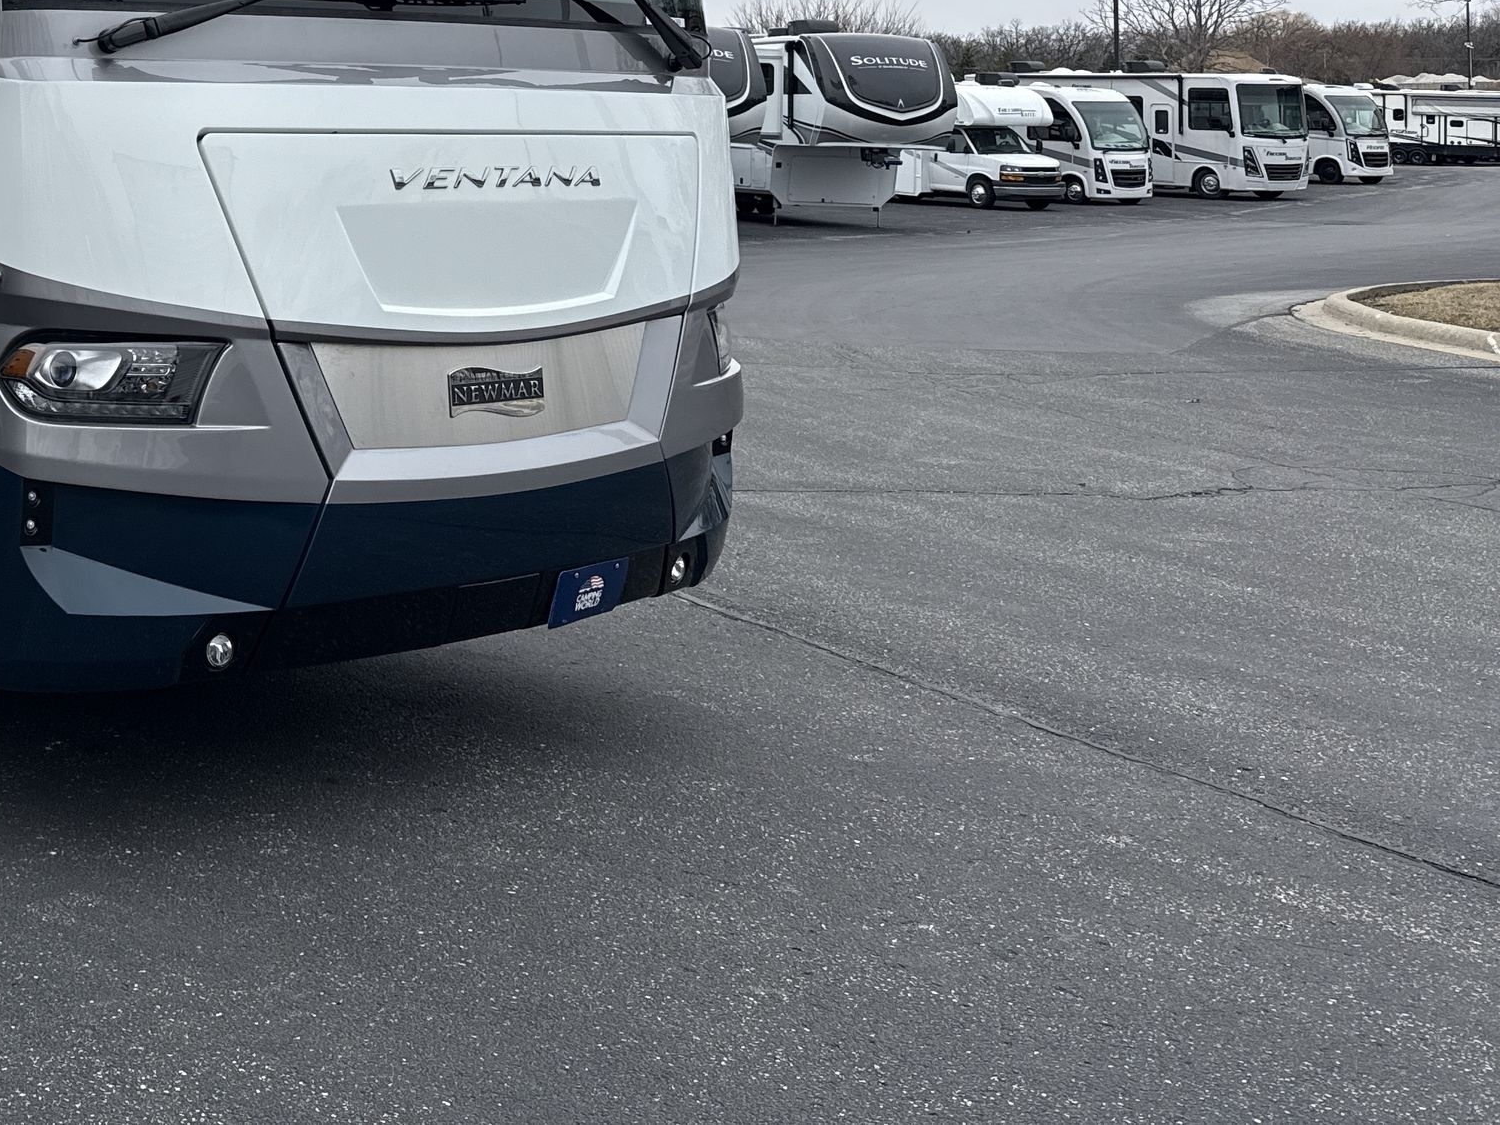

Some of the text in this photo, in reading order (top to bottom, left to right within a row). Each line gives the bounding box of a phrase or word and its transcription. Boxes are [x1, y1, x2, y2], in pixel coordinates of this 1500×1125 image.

[850, 55, 928, 69] SOLITUDE
[389, 165, 602, 191] VENTANA
[453, 380, 543, 405] NEWMAR
[574, 596, 601, 612] WORLD
[576, 589, 603, 604] CAMPING
